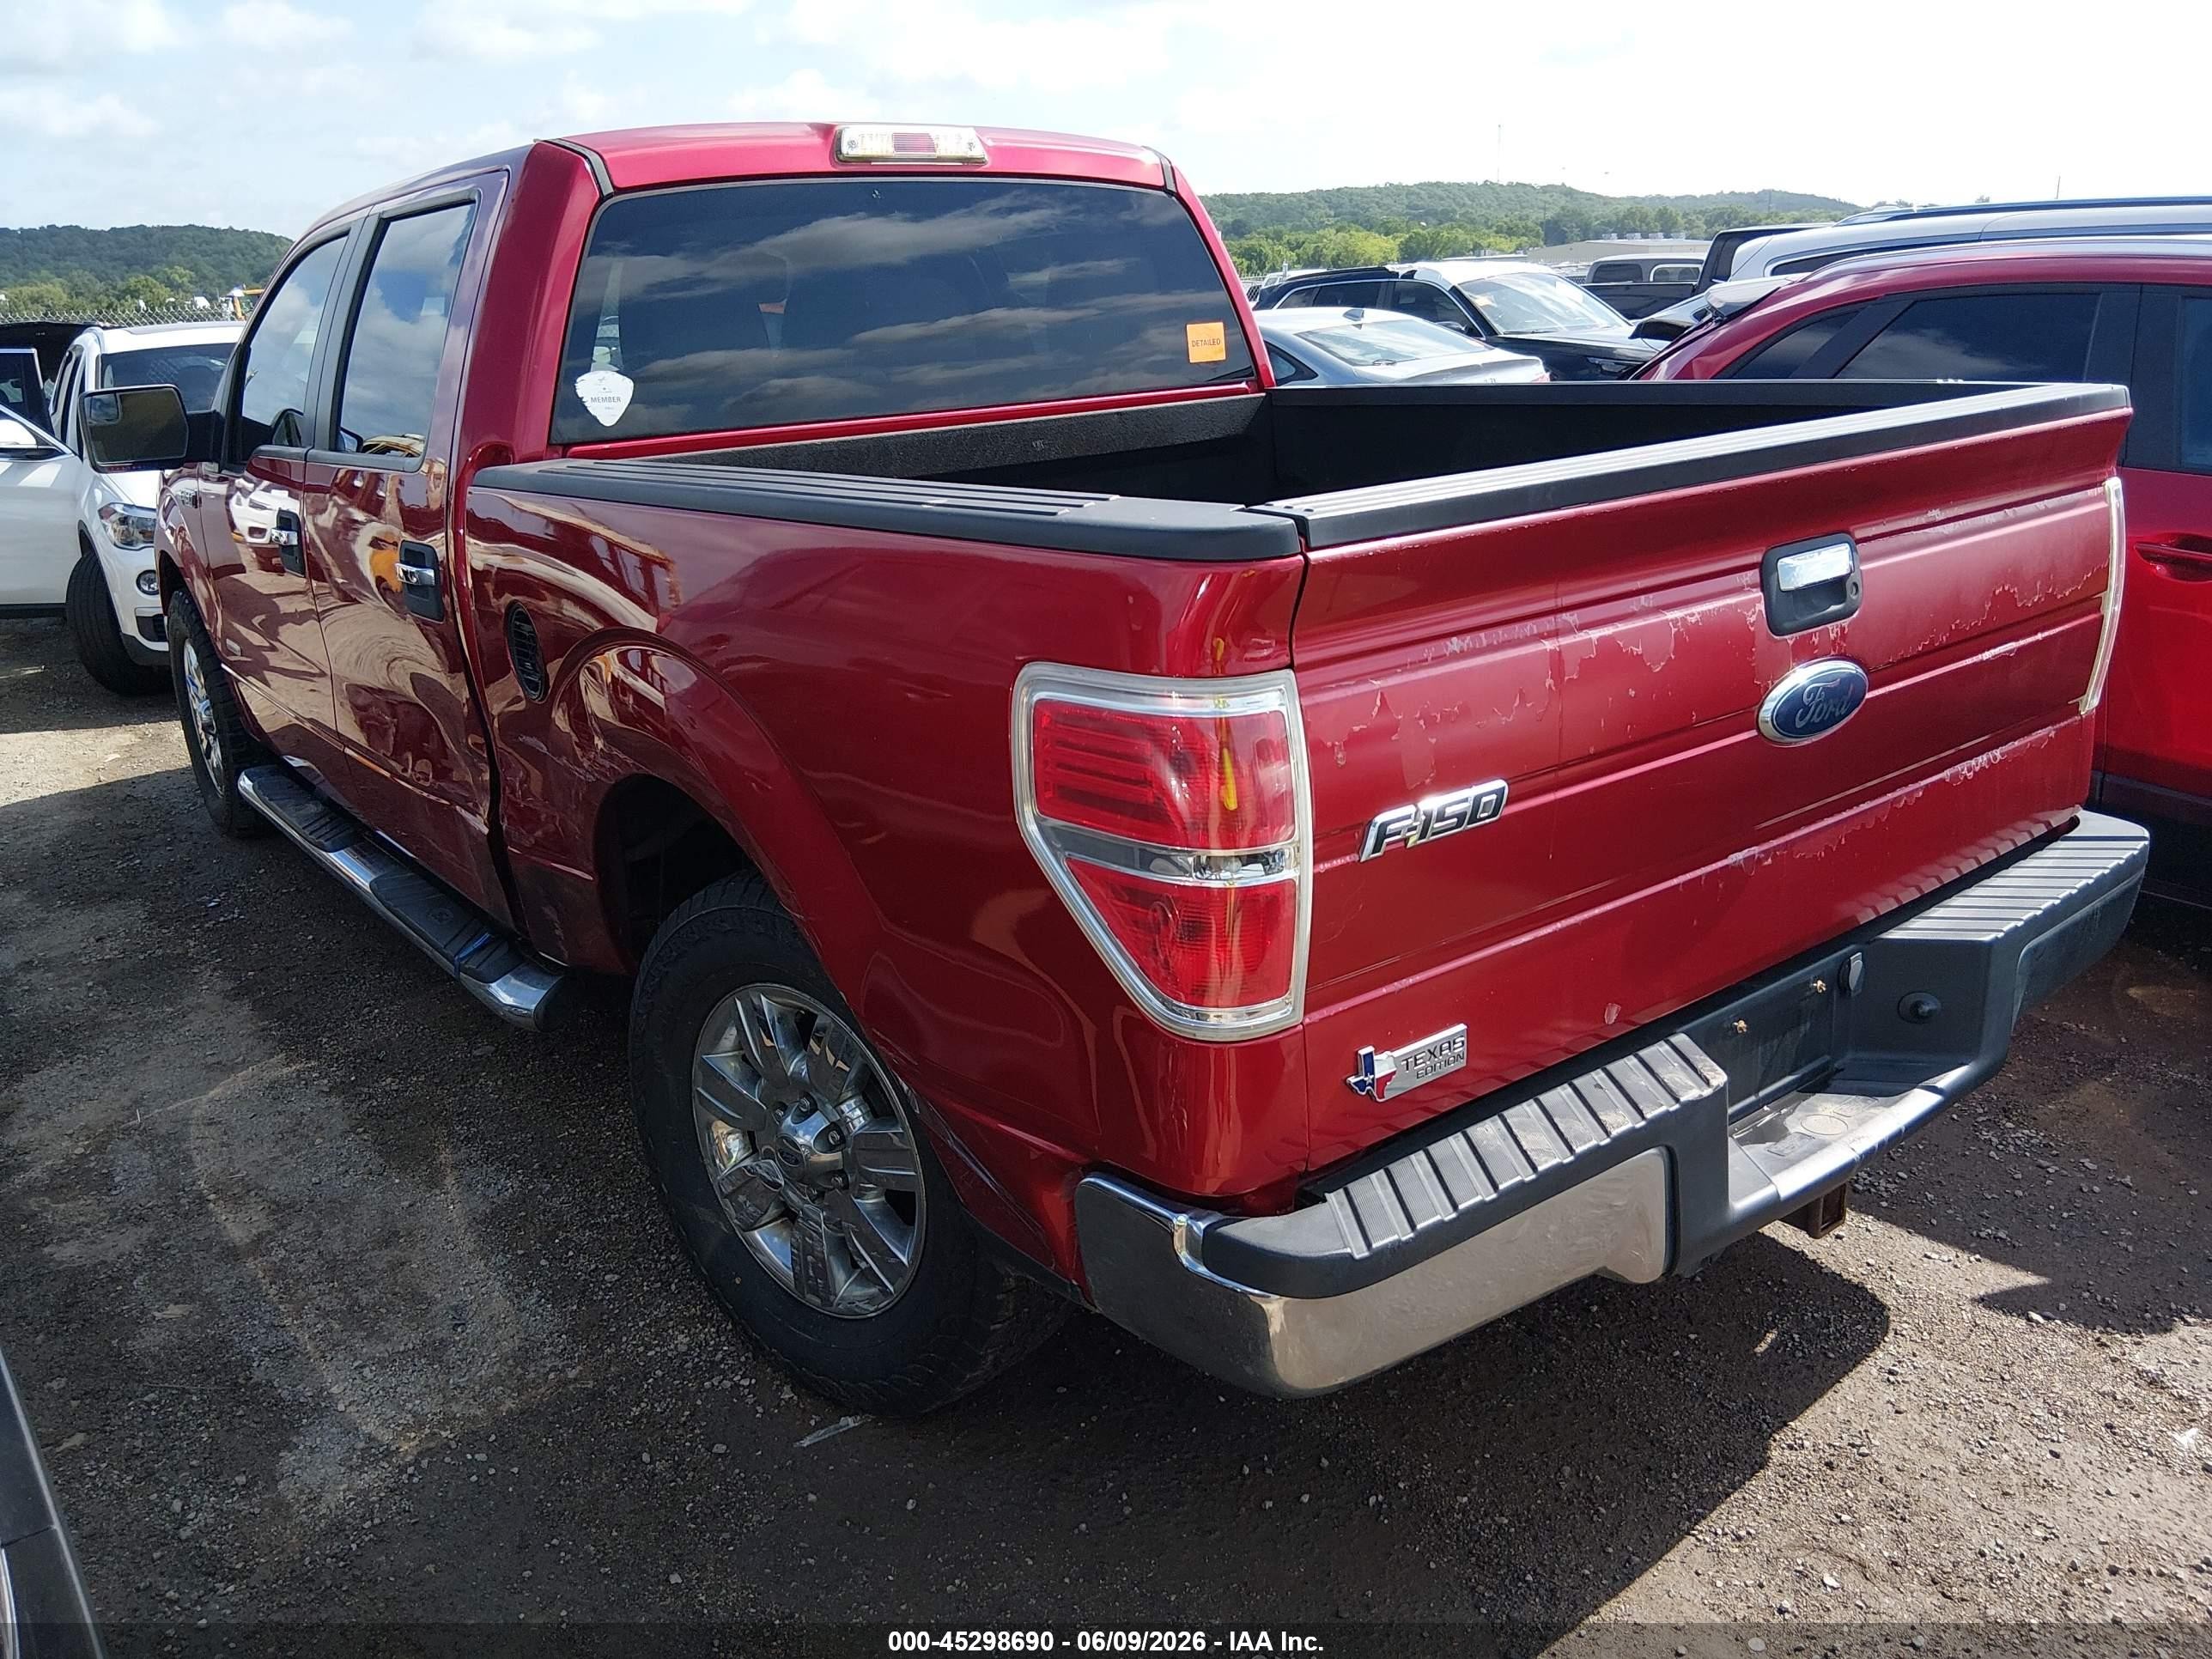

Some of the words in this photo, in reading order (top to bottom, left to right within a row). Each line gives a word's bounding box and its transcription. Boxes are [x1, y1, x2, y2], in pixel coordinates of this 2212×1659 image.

[1191, 337, 1221, 348] DETAILED
[1795, 678, 1854, 729] Ford
[1359, 778, 1509, 862] F-150
[1401, 1035, 1465, 1073] TEXAS
[1415, 1051, 1465, 1079] EDITION
